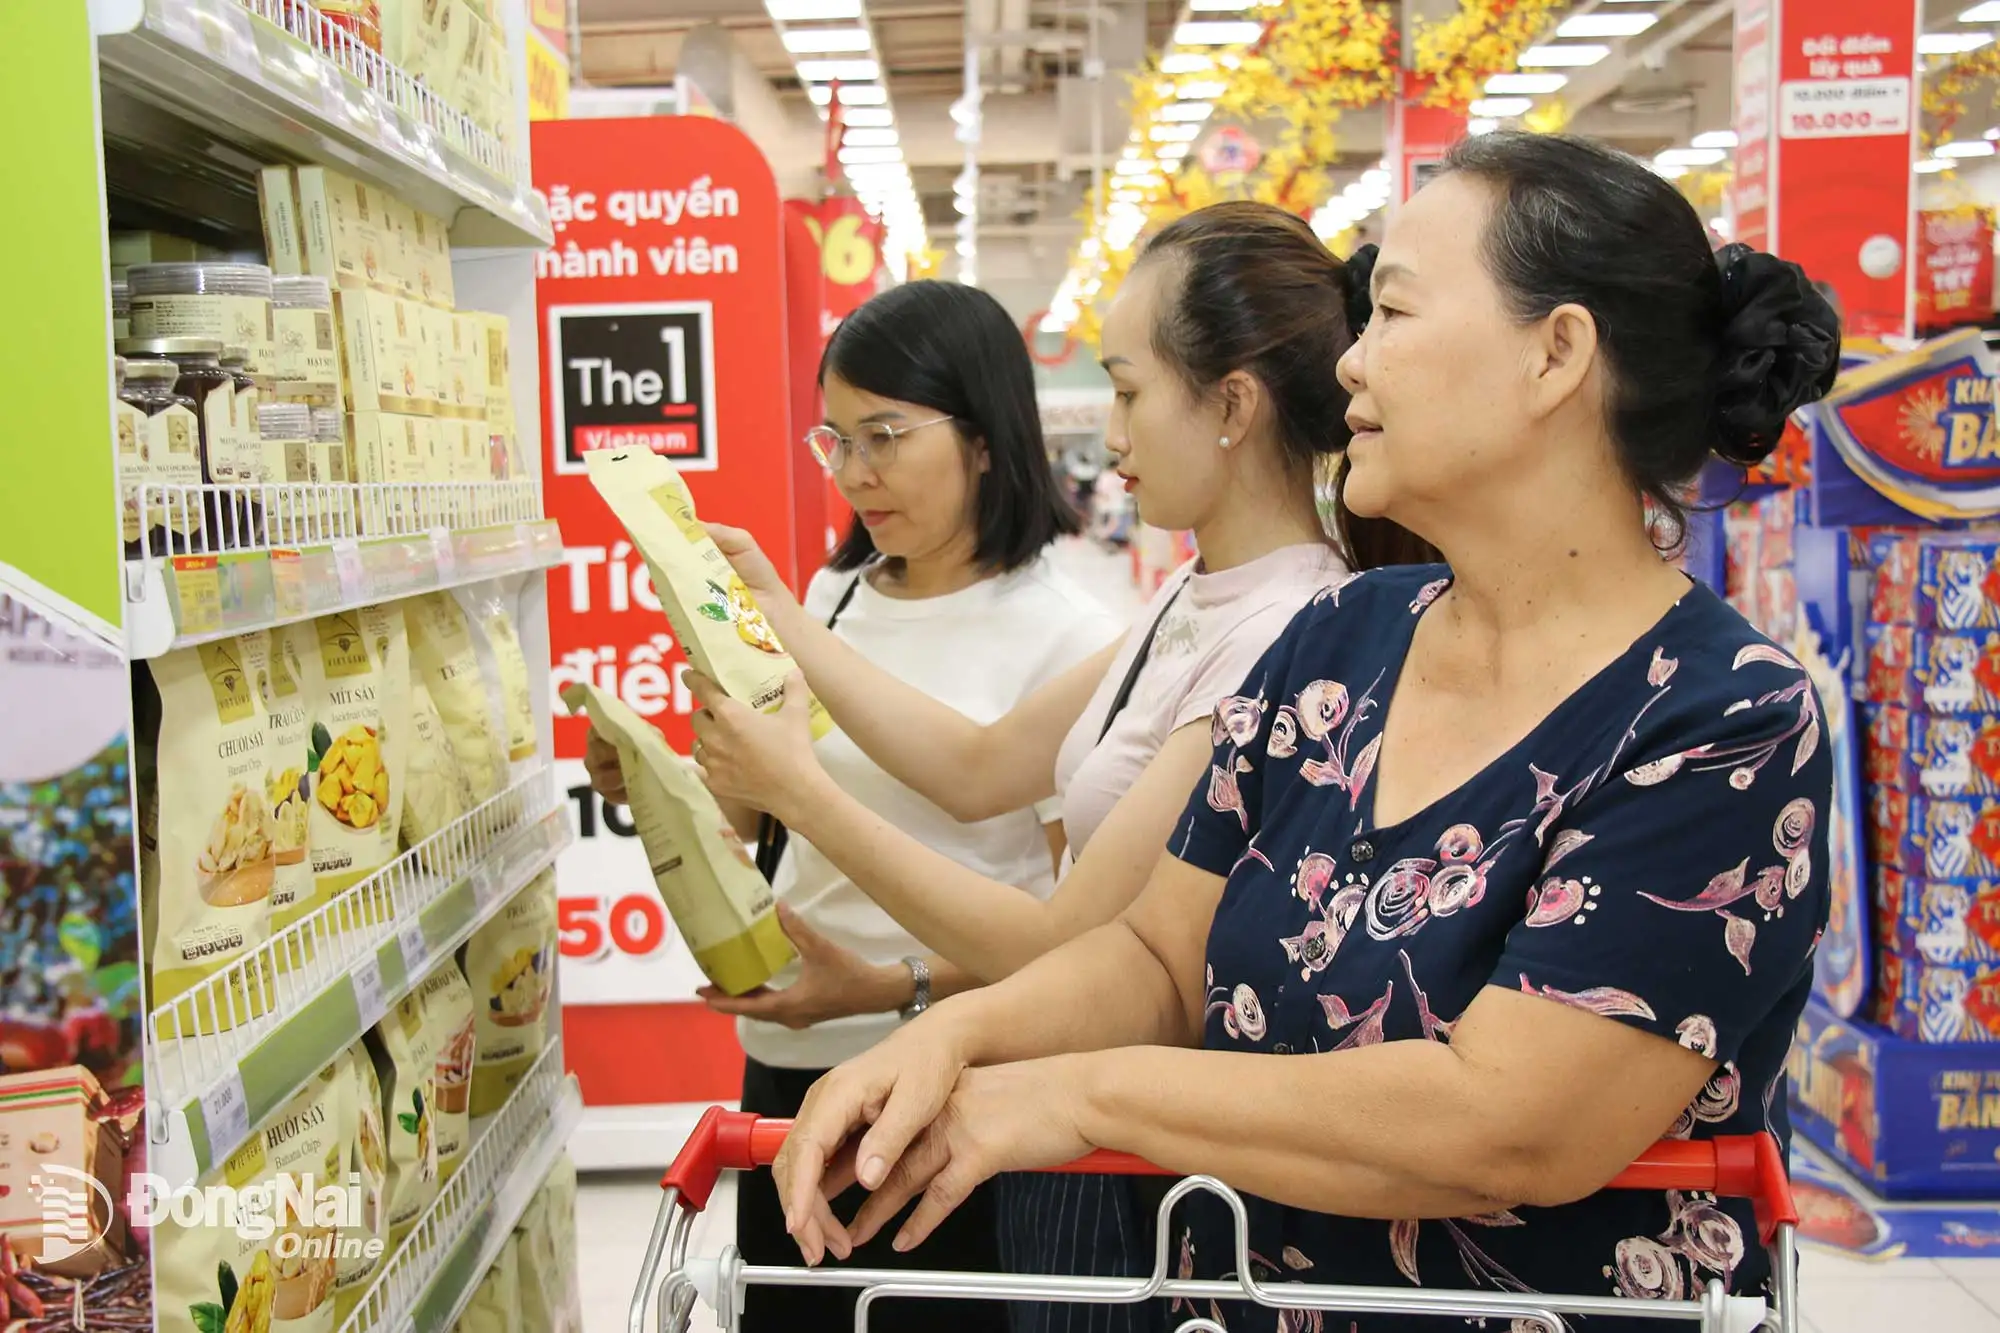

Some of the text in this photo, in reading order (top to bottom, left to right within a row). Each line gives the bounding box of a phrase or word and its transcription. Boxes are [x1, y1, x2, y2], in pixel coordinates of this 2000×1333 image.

[533, 184, 598, 232] ặc
[535, 236, 739, 279] hành viên
[568, 326, 688, 406] The 1
[562, 538, 664, 614] Tíc
[556, 893, 666, 960] 50
[265, 1113, 300, 1150] HUỐI
